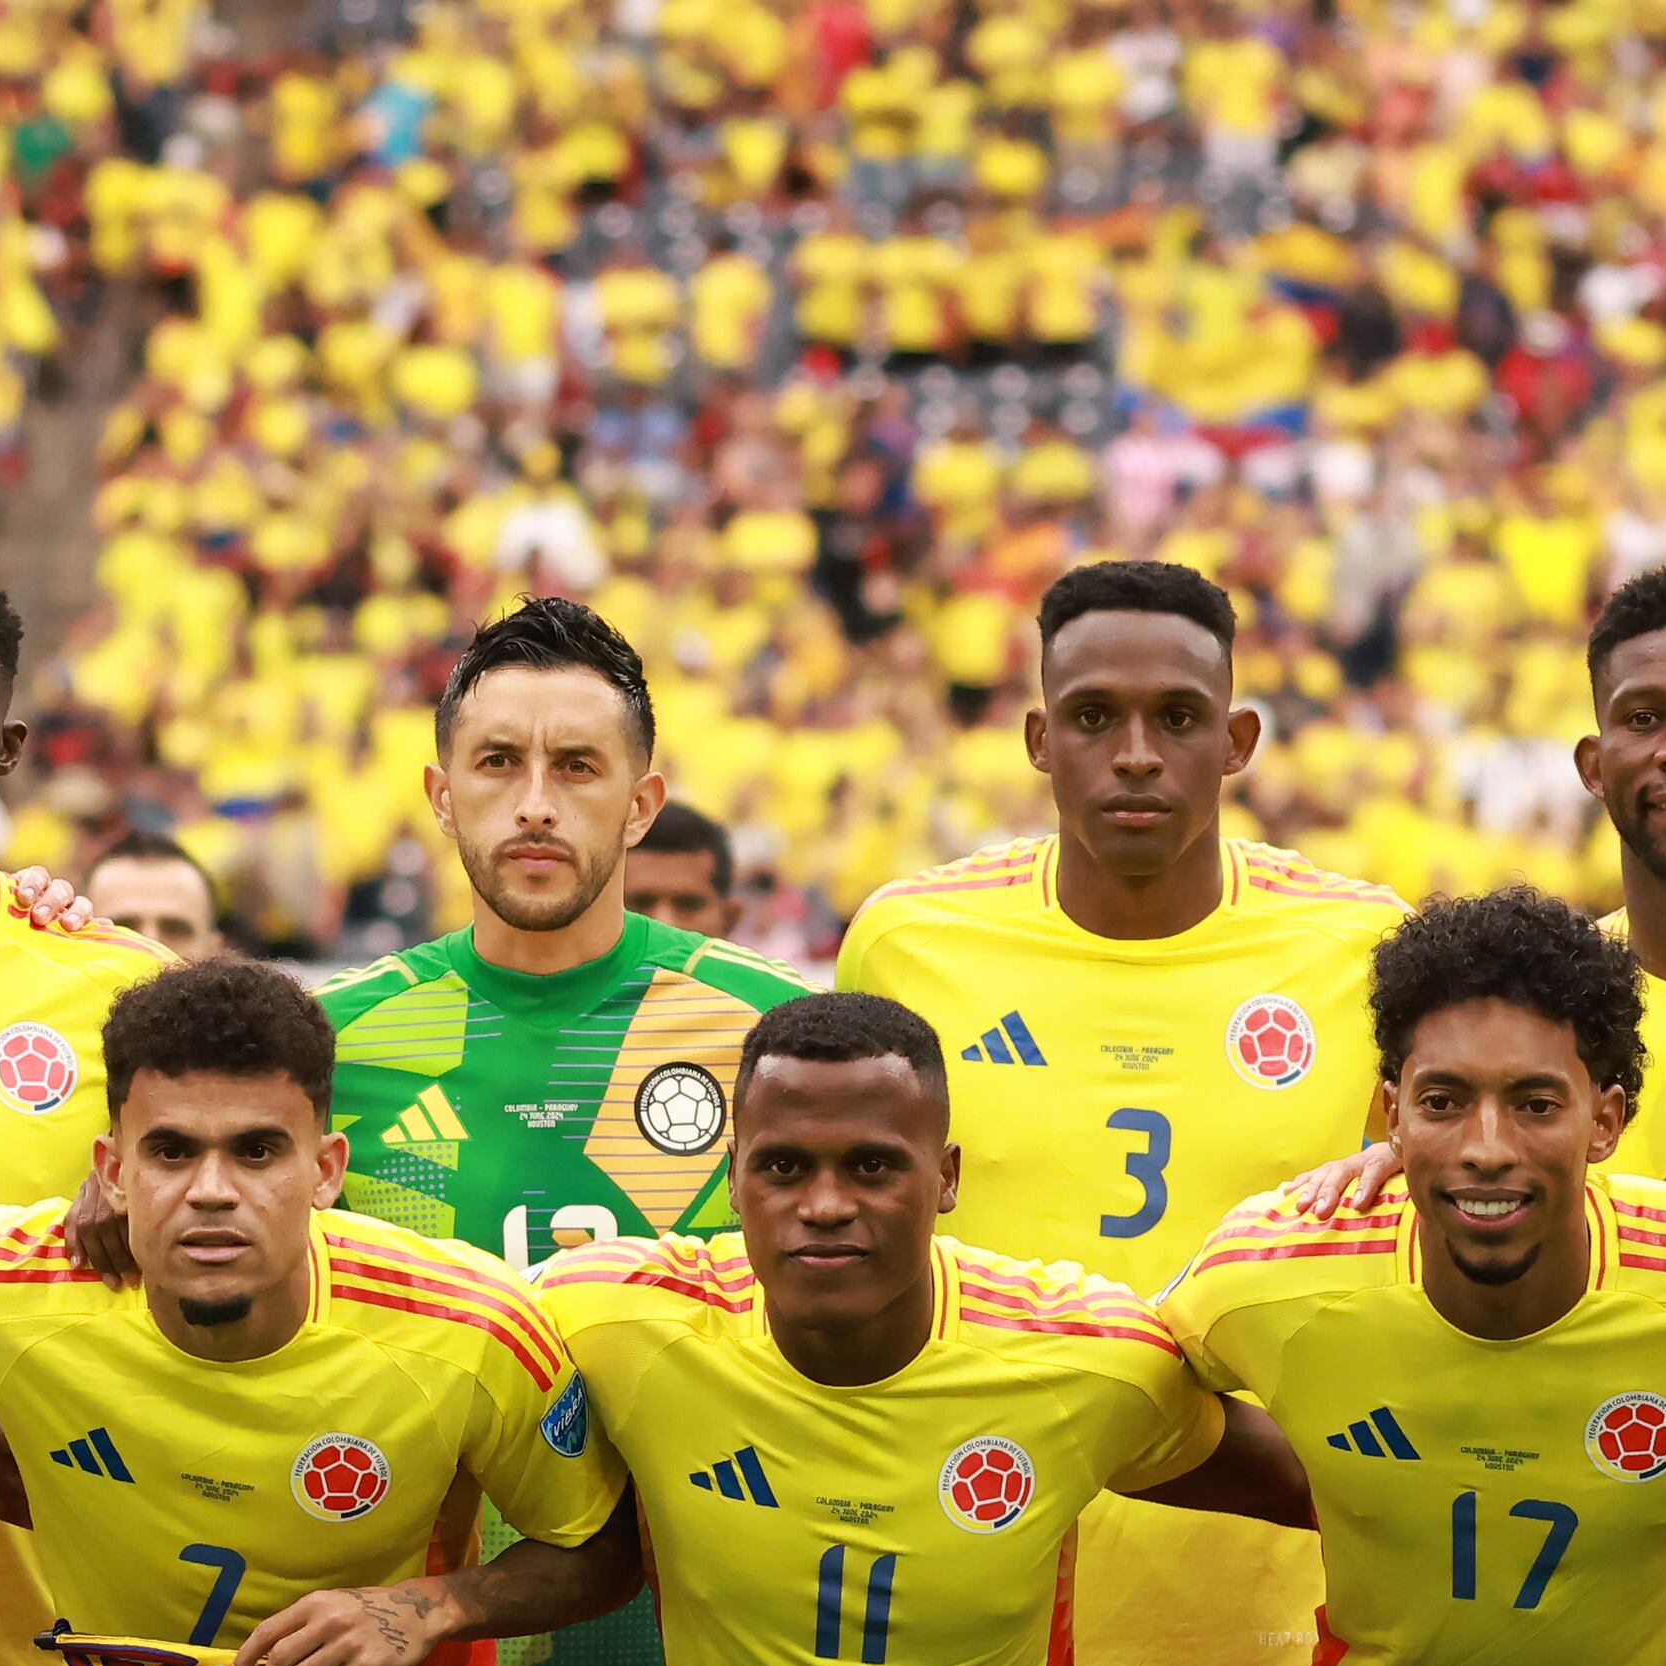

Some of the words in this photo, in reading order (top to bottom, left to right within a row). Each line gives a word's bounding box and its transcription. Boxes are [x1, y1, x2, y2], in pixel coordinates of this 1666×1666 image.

[504, 1104, 537, 1113] COLOMBIA
[544, 1103, 578, 1112] PARAGUAY
[519, 1112, 528, 1120] 24
[546, 1112, 563, 1120] 2024
[1099, 1107, 1172, 1238] 3
[1612, 1394, 1659, 1406] COLOMBIANA
[322, 1435, 368, 1450] COLOMBIANA
[374, 1453, 388, 1478] FUTBOL
[963, 1439, 1008, 1452] COLOMBIANA
[1016, 1452, 1030, 1475] FUTBOL
[1452, 1491, 1579, 1609] 17
[179, 1543, 247, 1647] 7
[815, 1543, 897, 1664] 11
